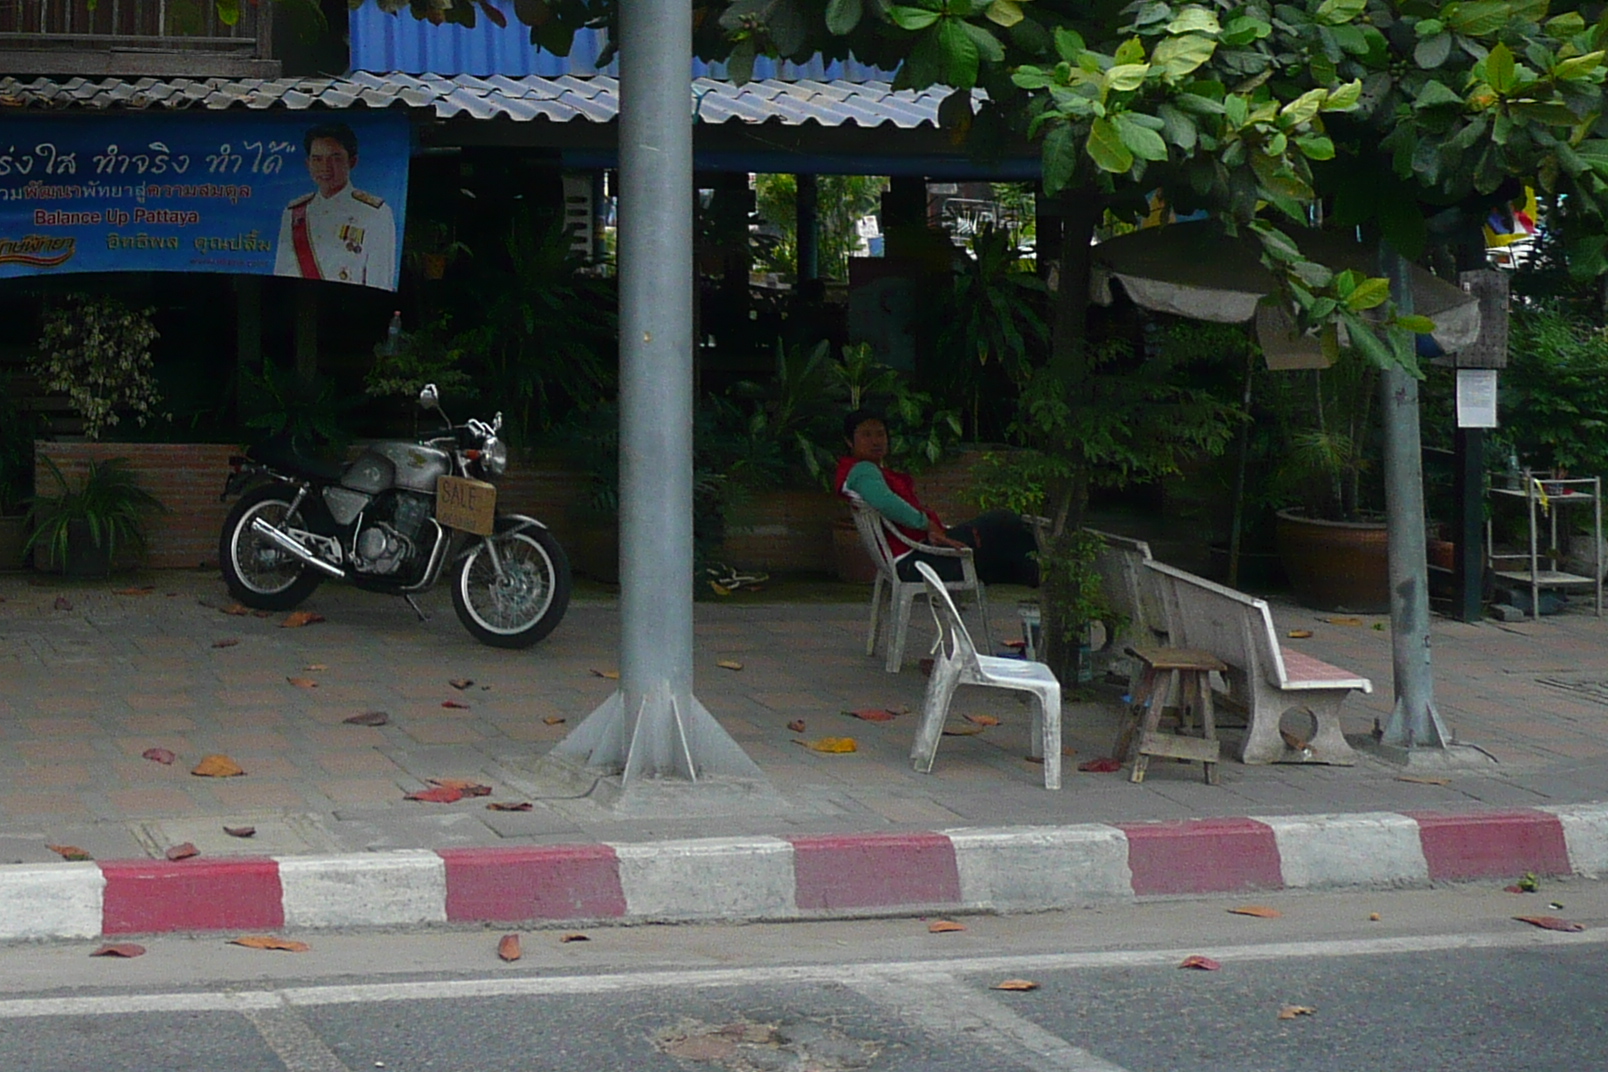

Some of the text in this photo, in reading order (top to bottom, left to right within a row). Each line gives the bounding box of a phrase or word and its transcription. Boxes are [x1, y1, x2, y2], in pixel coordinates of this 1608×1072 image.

[34, 206, 200, 227] Balance Up Pattaya
